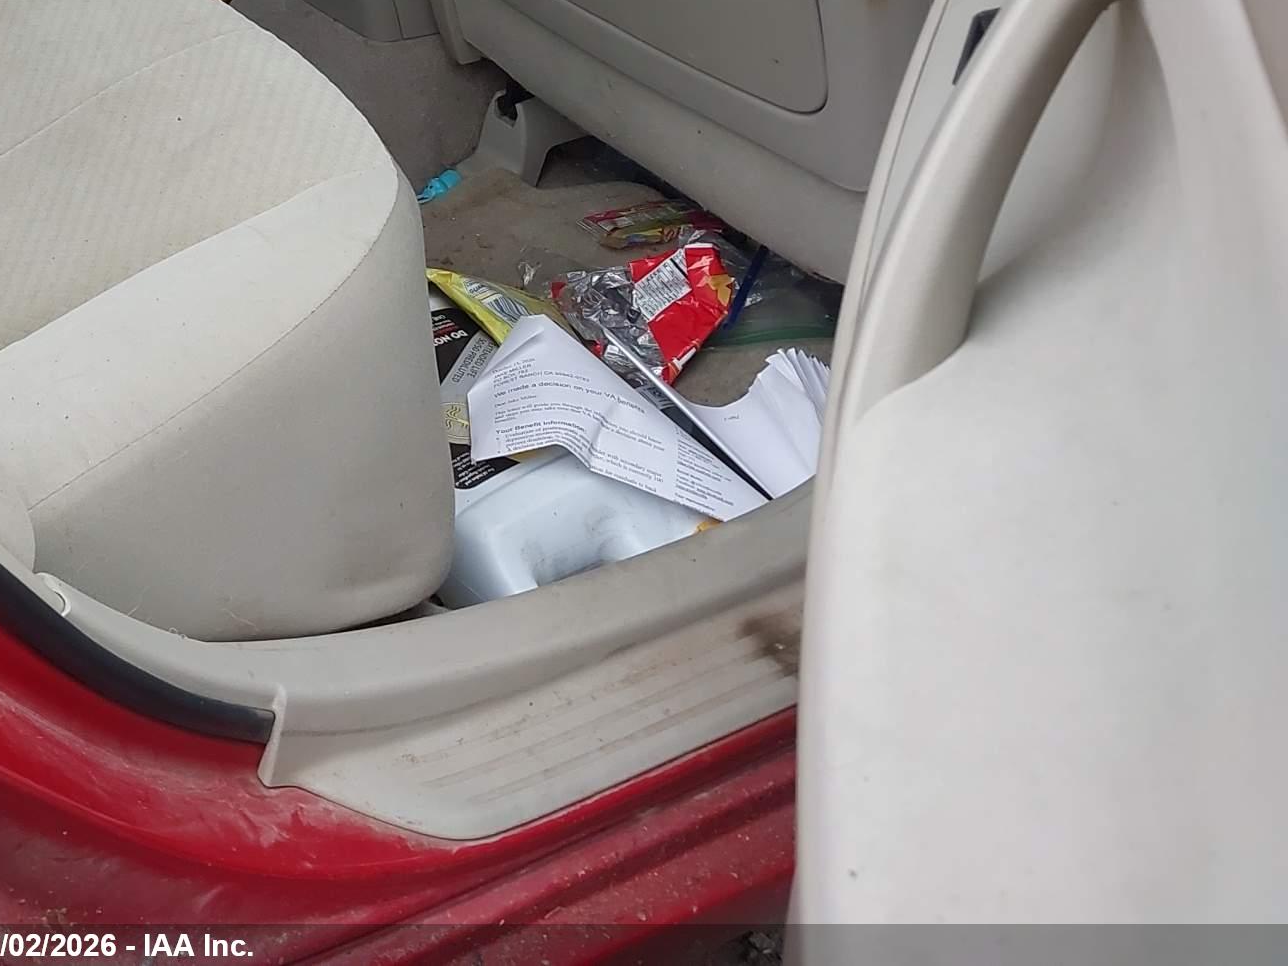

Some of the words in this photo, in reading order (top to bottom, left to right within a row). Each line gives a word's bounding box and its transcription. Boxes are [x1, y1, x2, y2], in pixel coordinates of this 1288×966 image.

[451, 329, 469, 339] DO
[451, 349, 477, 383] PREDILUTED
[508, 383, 530, 393] made
[538, 381, 572, 389] decision
[585, 387, 603, 395] your
[603, 392, 617, 400] VA
[495, 426, 513, 434] Your
[514, 421, 542, 431] Benefit
